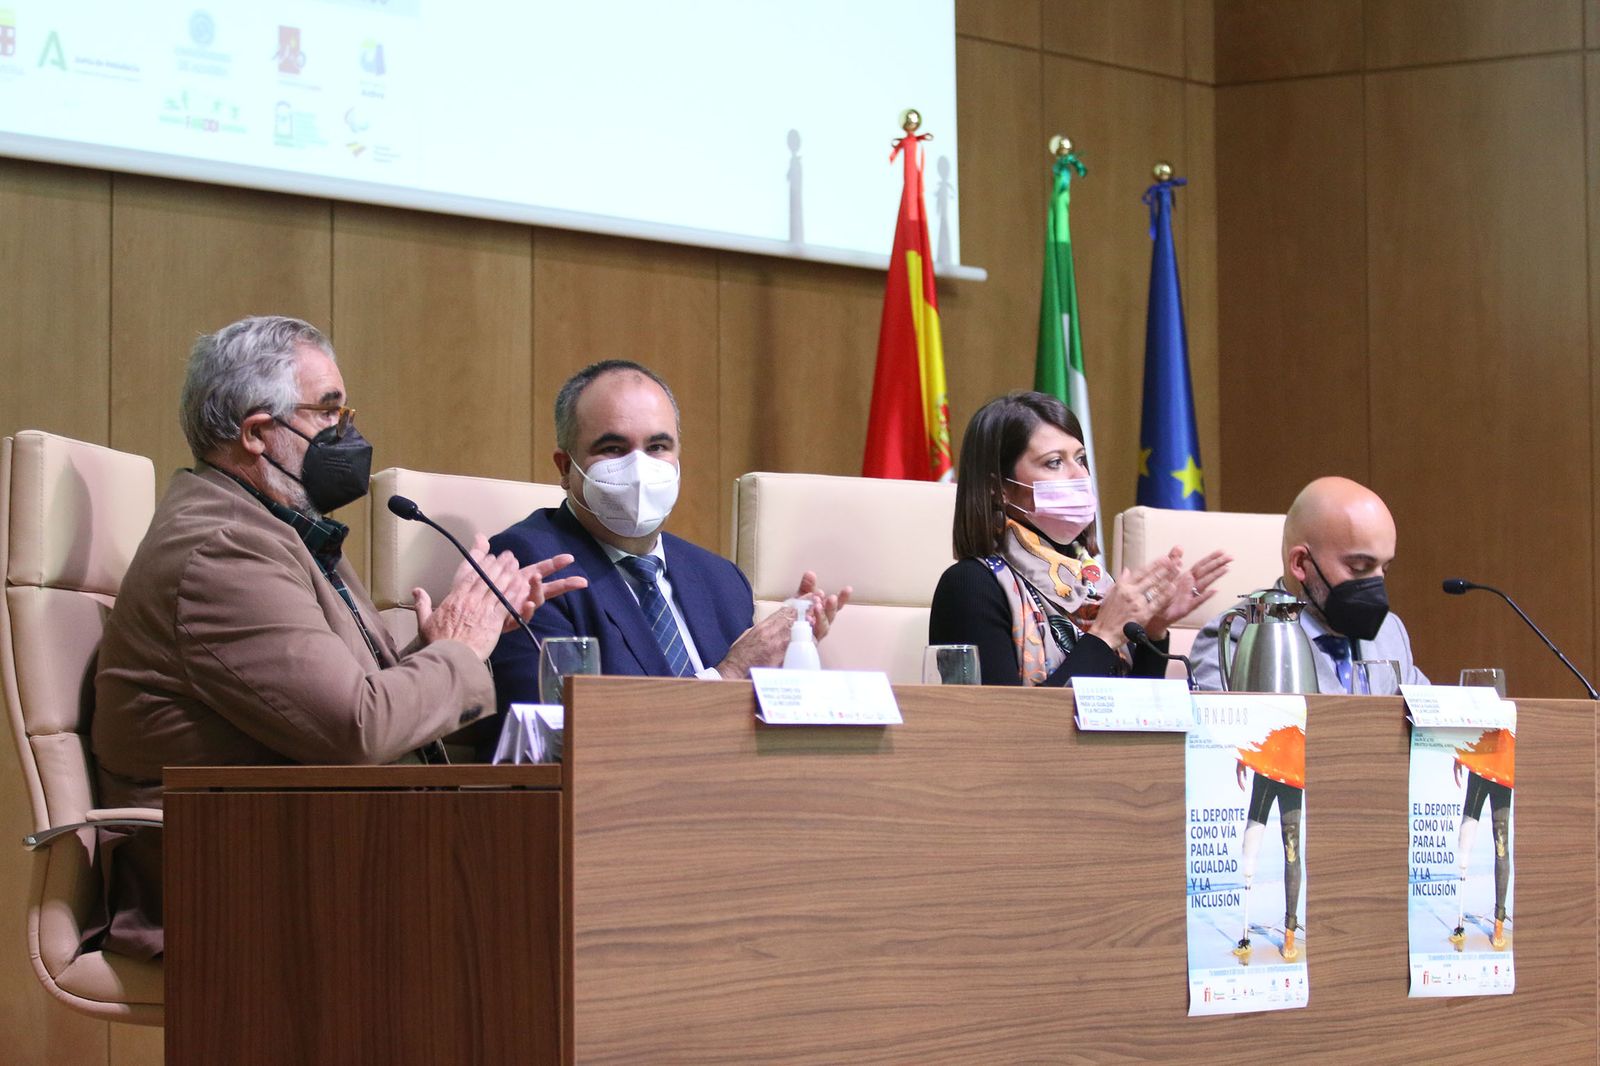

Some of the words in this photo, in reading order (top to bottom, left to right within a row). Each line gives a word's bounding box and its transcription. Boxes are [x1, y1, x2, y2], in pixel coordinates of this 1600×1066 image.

[1194, 707, 1249, 725] ORNADAS
[1190, 809, 1200, 822] EL
[1203, 808, 1245, 822] DEPORTE
[1413, 803, 1422, 815] EL
[1424, 803, 1461, 816] DEPORTE
[1190, 826, 1218, 839] COMO
[1221, 823, 1237, 838] VÍA
[1413, 819, 1438, 832] COMO
[1412, 835, 1434, 847] PARA
[1436, 835, 1446, 847] LA
[1190, 843, 1214, 856] PARA
[1217, 842, 1228, 856] LA
[1412, 851, 1454, 864] IGUALDAD
[1190, 859, 1238, 873] IGUALDAD
[1412, 867, 1418, 880] Y
[1420, 867, 1431, 880] LA
[1191, 878, 1196, 890] Y
[1200, 878, 1211, 890] LA
[1191, 892, 1240, 908] INCLUSIÓN
